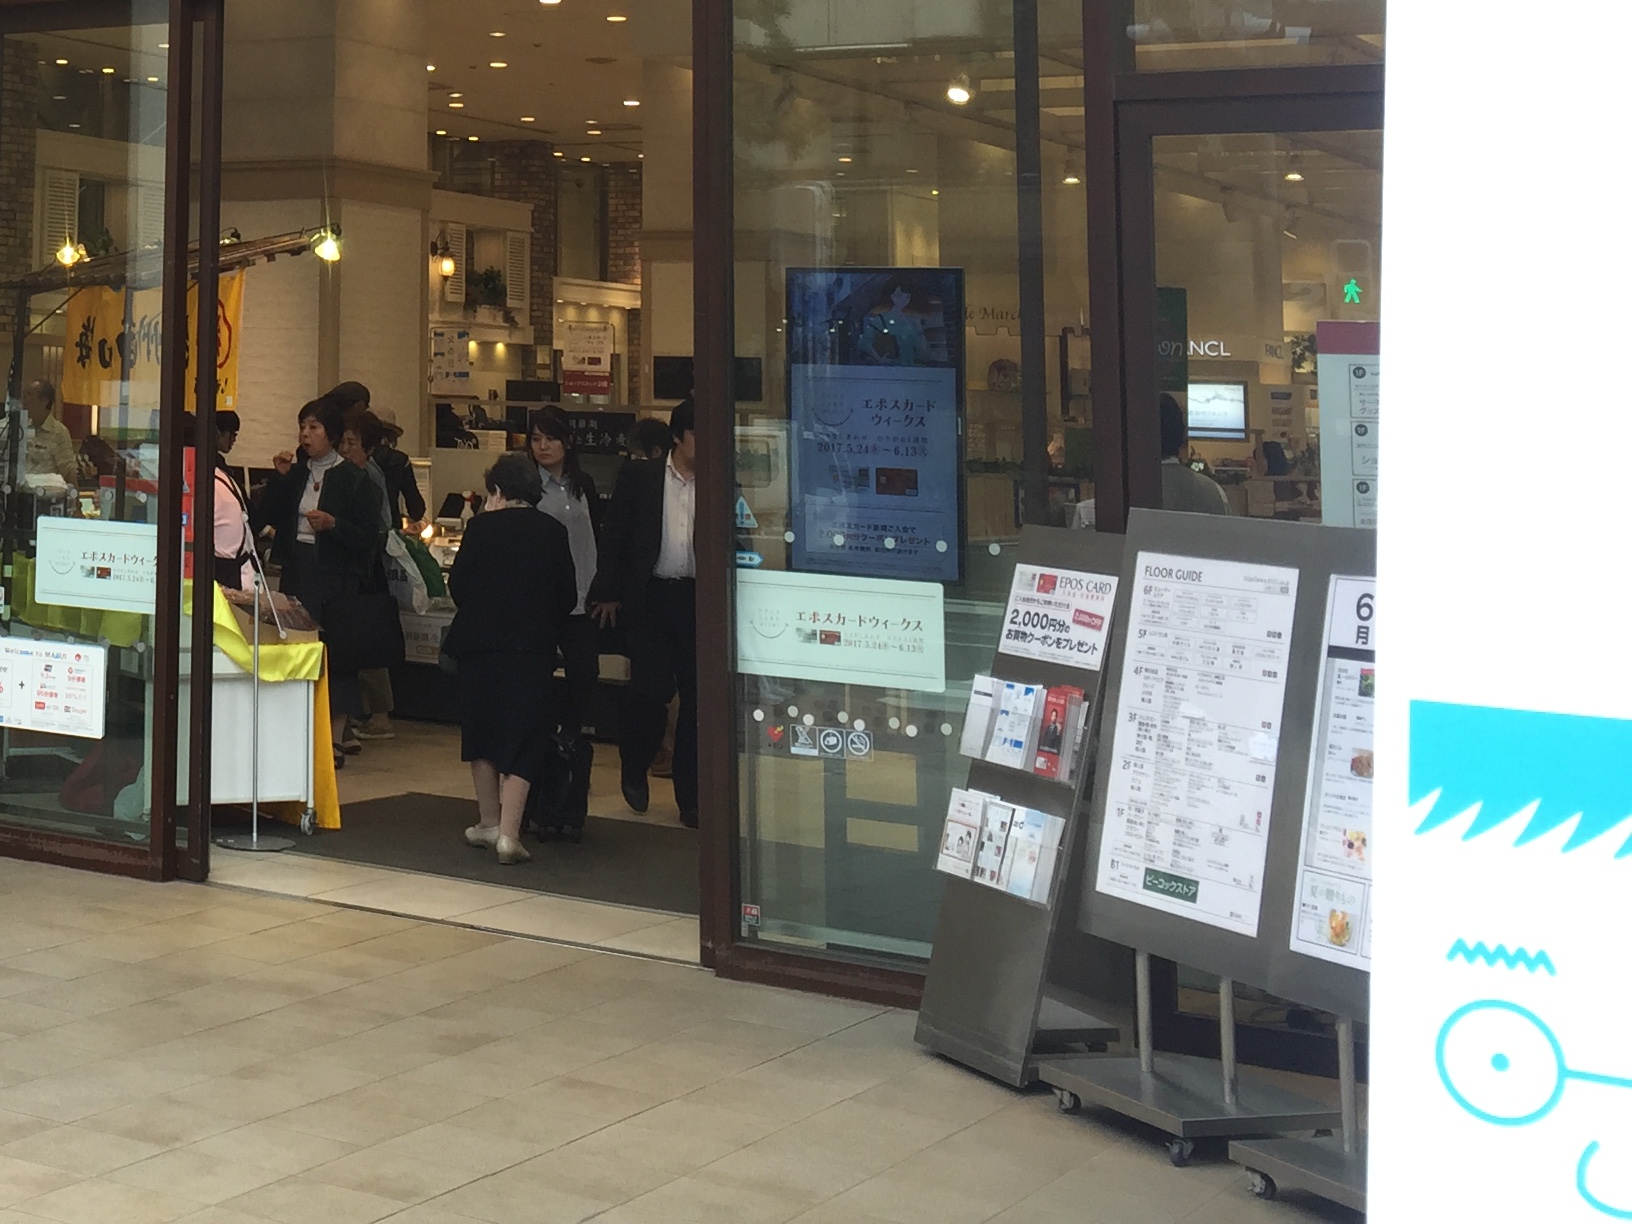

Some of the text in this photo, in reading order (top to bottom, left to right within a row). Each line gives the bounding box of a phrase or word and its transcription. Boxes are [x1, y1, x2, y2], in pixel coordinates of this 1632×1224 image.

[1187, 340, 1232, 357] NCL
[862, 398, 937, 413] エポスカード
[871, 413, 927, 428] ウィークス
[1144, 565, 1203, 583] FLOOR GUIDE
[1059, 576, 1112, 595] EPOS CARD
[1143, 585, 1153, 596] 6F
[1355, 593, 1374, 622] 6
[796, 610, 924, 633] エポスカードウィークス
[1009, 608, 1071, 634] 2,000円分の
[1005, 628, 1098, 655] お買物クーポンをプレゼント
[1354, 624, 1370, 646] 月
[1133, 666, 1144, 676] 4F
[1128, 712, 1138, 723] 3F
[1122, 760, 1132, 771] 2F
[1145, 874, 1197, 897] ピーコックストア
